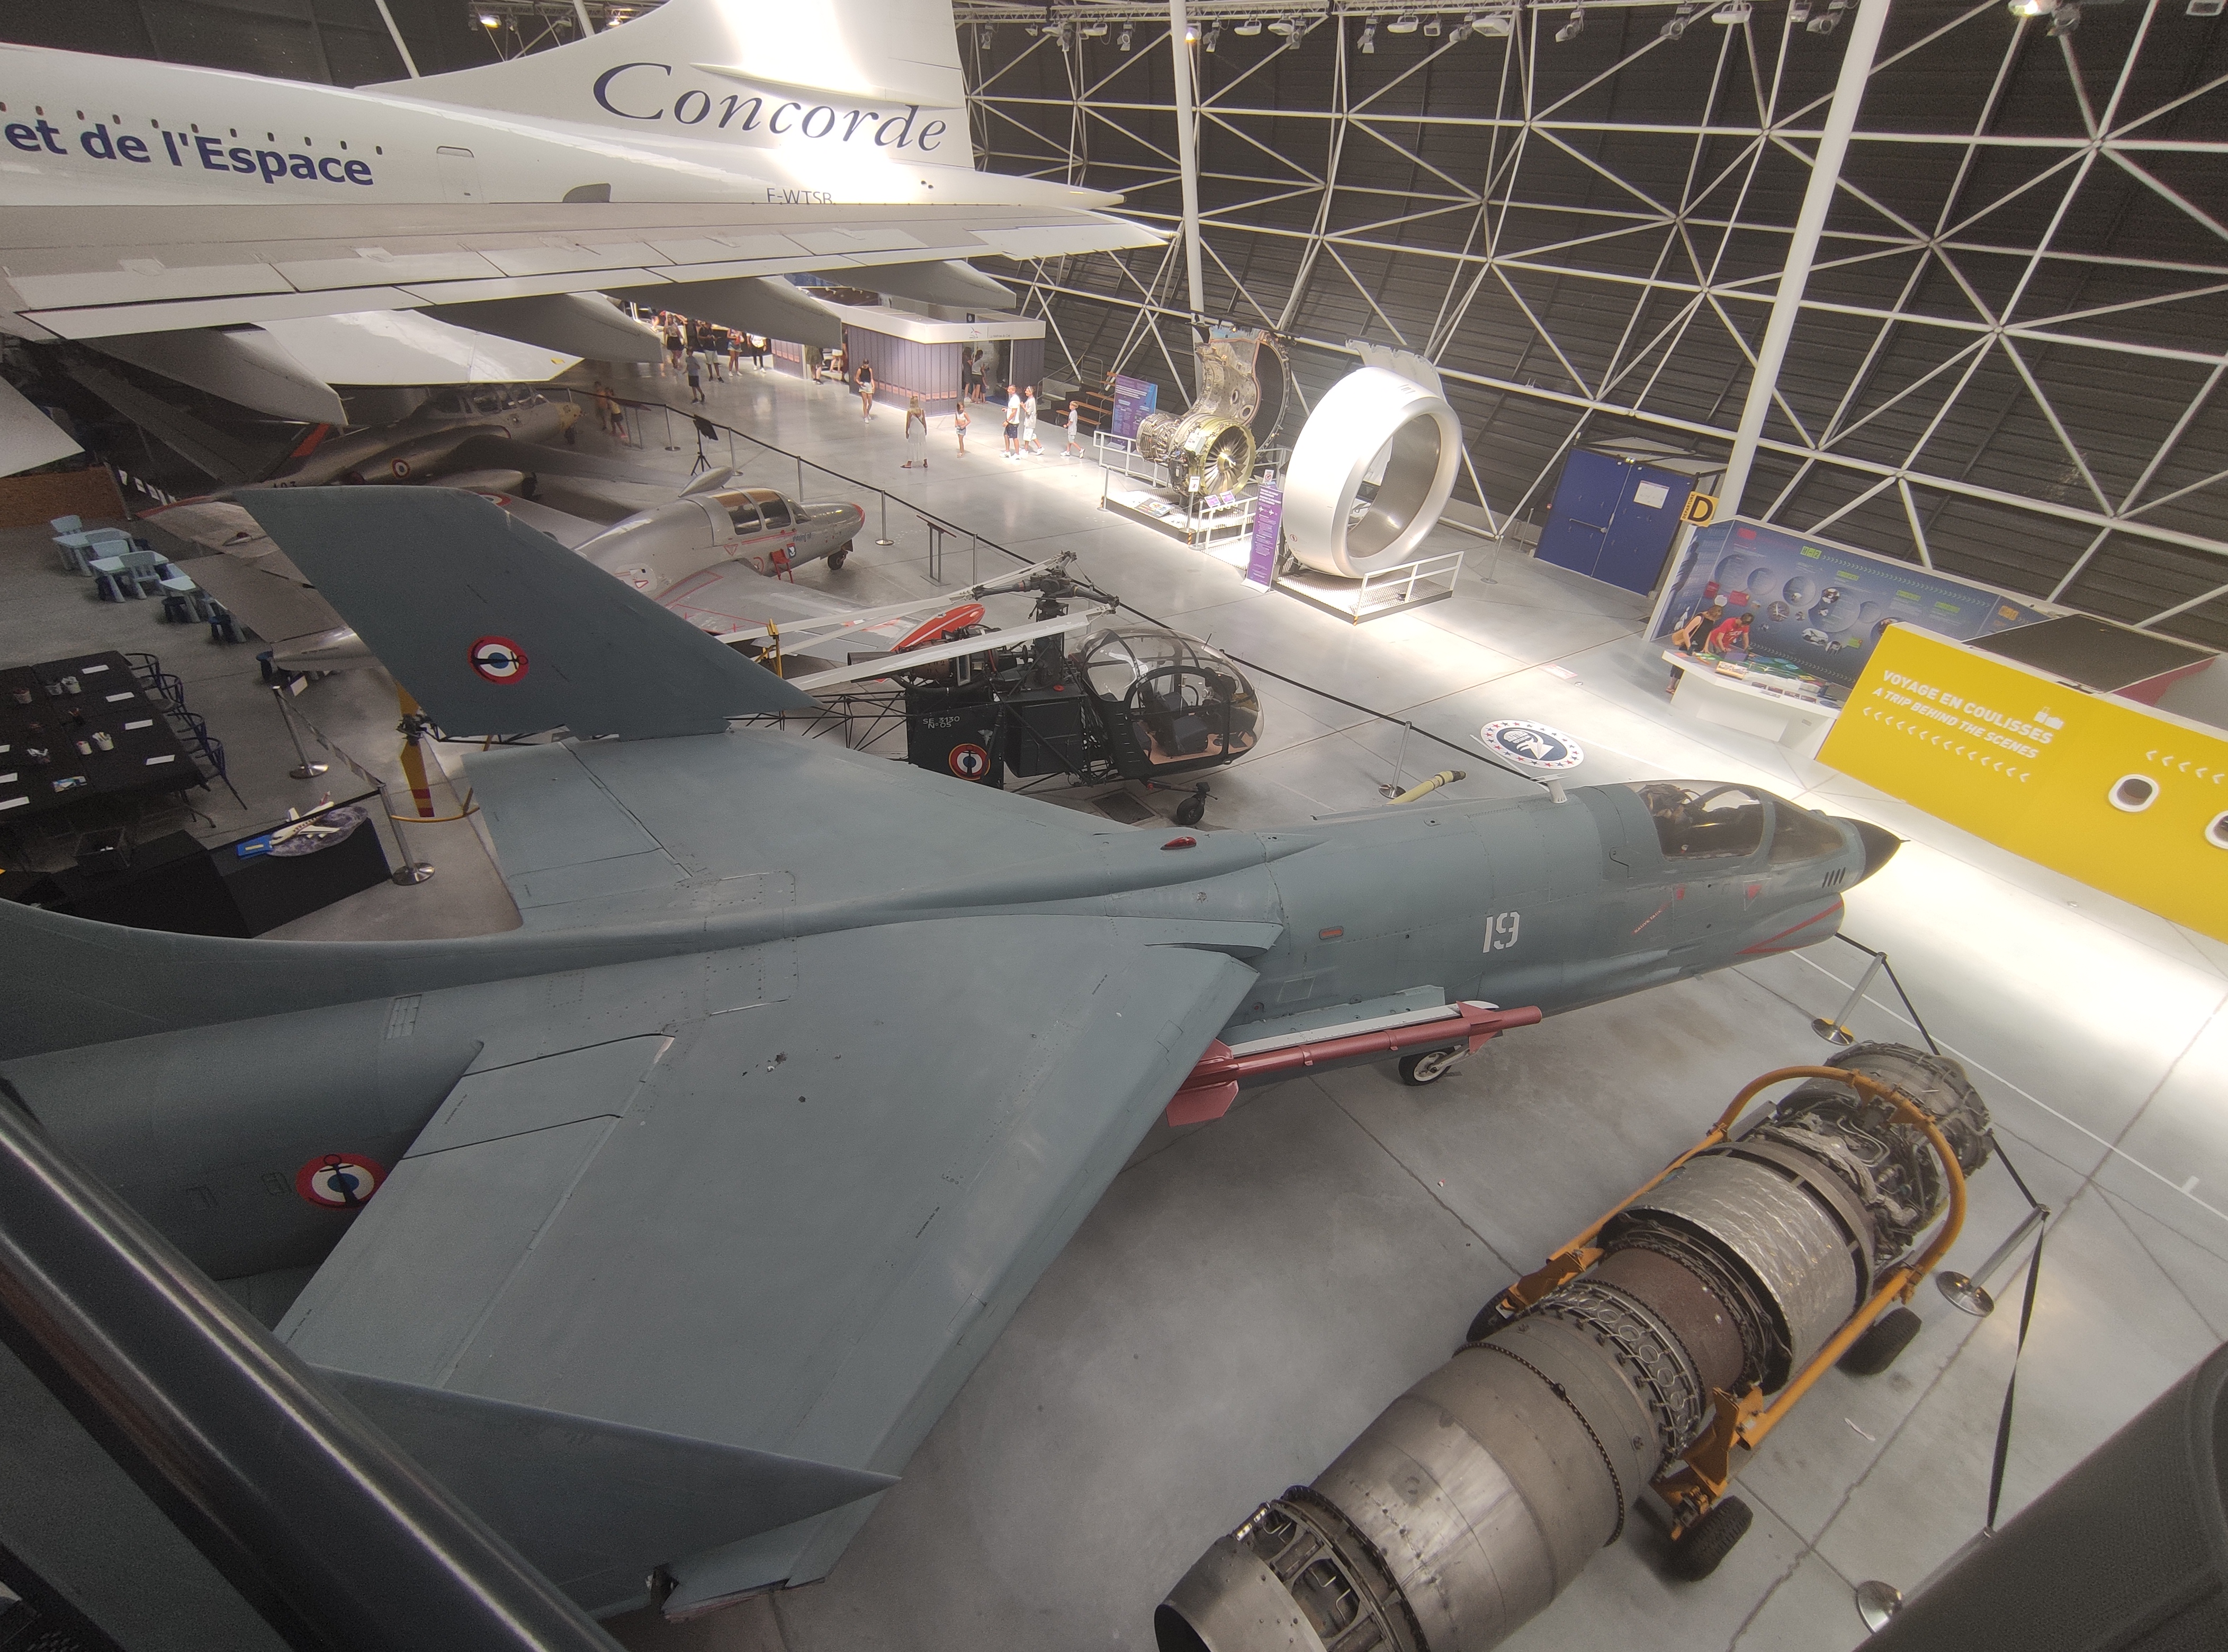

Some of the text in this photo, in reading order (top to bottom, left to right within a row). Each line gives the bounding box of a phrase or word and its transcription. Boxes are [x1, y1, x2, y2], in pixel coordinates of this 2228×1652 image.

[592, 62, 947, 151] Concorde
[4, 119, 374, 186] et de l'Espace
[767, 187, 833, 204] F-WTSB
[1682, 493, 1695, 519] DEPARTURE
[1687, 495, 1713, 522] D
[1872, 687, 2040, 758] A TRIP BEHIND THE SCENES
[1883, 670, 2054, 744] VOYAGE EN COULISSES
[1483, 911, 1520, 954] 19
